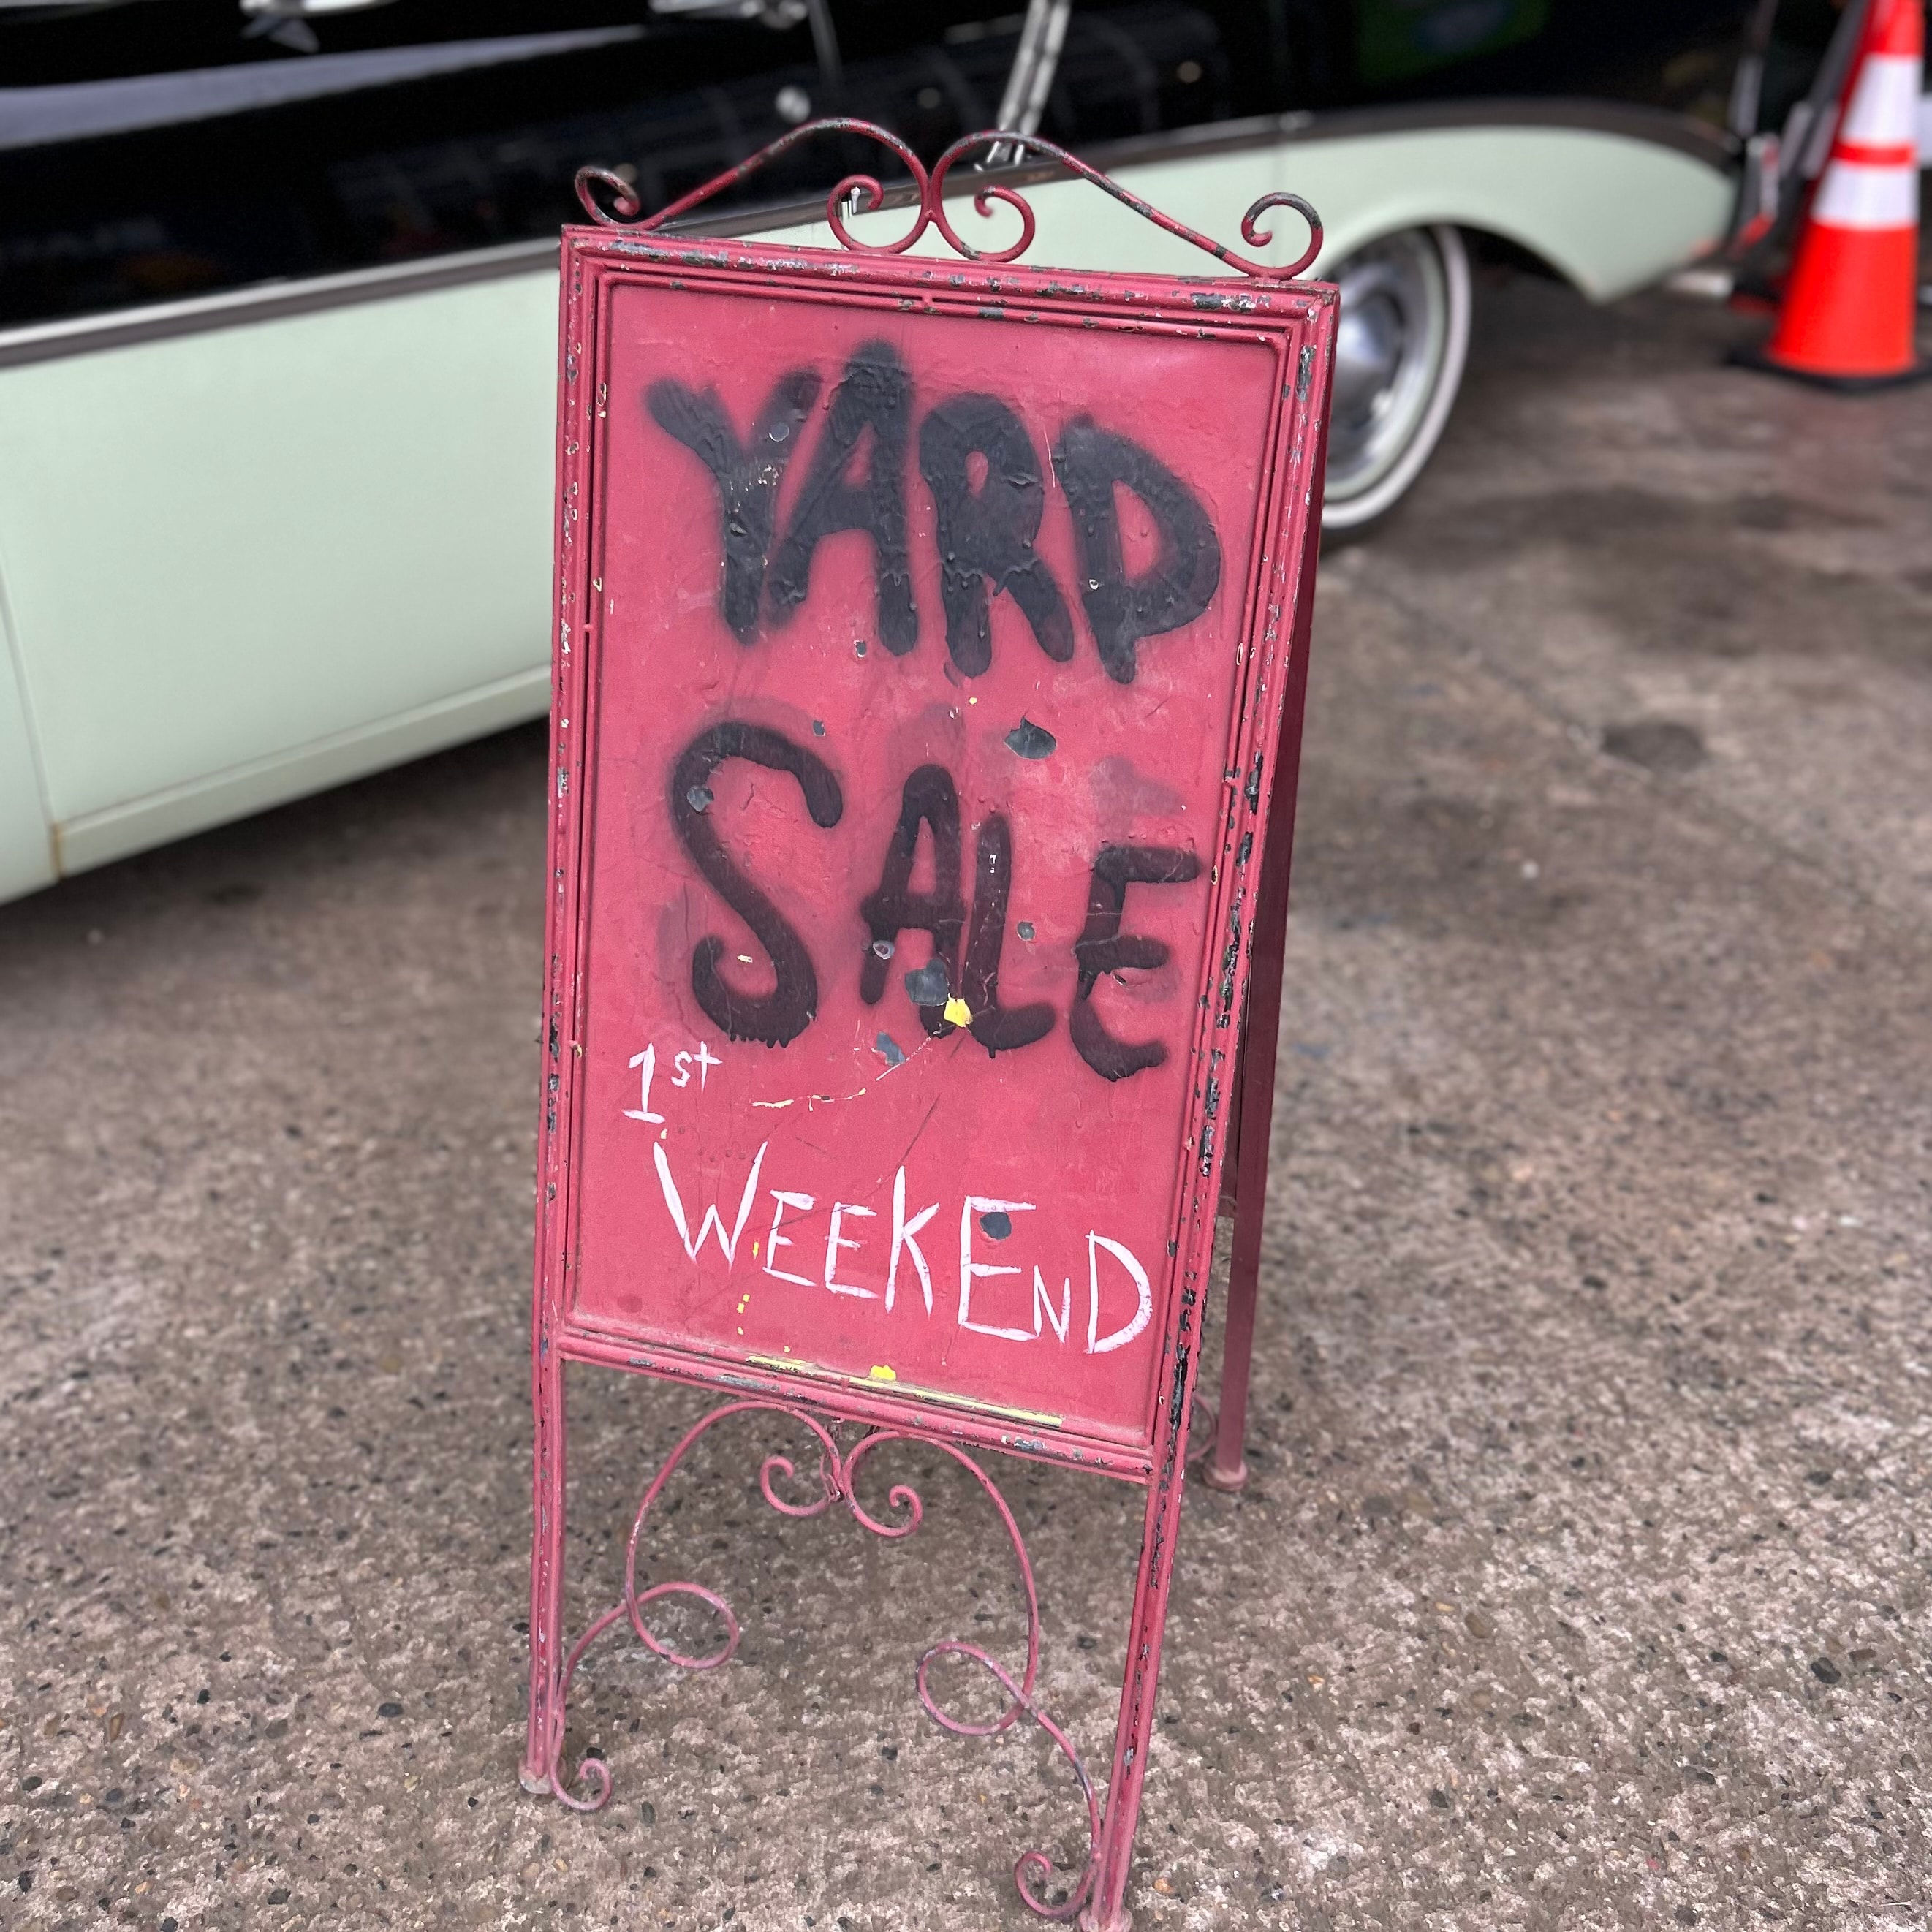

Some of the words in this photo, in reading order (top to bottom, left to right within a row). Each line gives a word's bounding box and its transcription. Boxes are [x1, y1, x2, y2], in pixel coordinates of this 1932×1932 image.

[643, 338, 1221, 684] YARD
[673, 720, 1202, 1081] SALE
[621, 1042, 723, 1124] 1st
[652, 1140, 1153, 1355] WEEKEND
